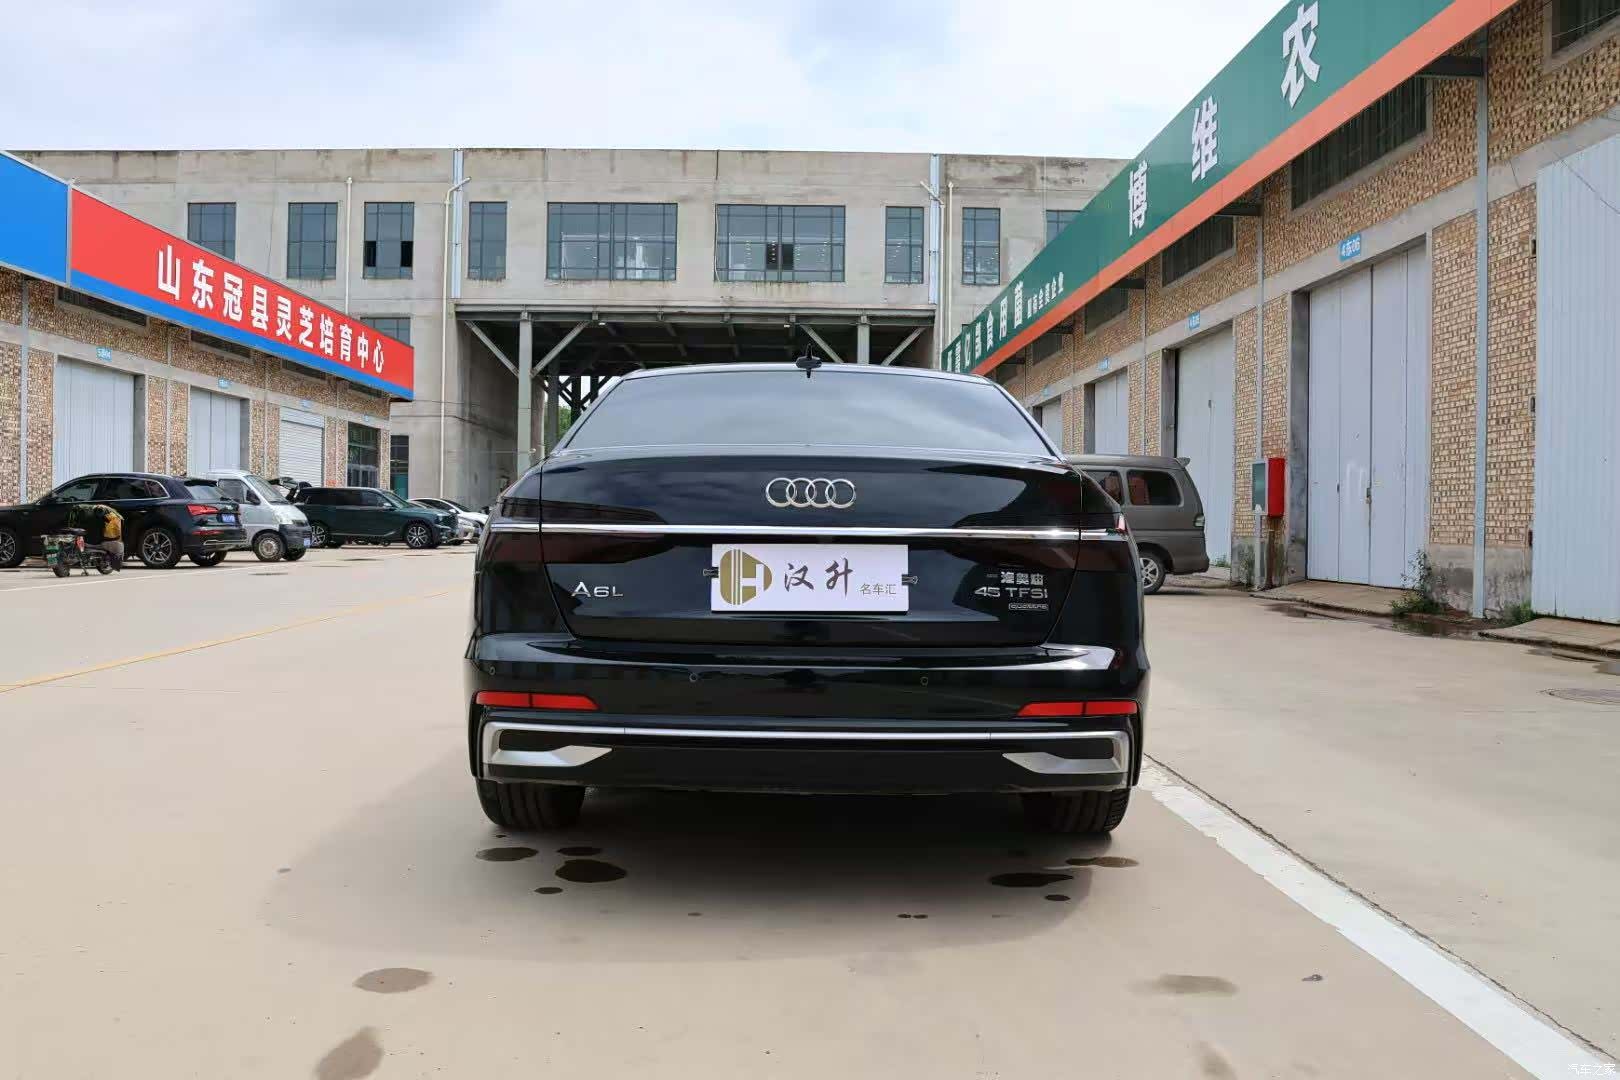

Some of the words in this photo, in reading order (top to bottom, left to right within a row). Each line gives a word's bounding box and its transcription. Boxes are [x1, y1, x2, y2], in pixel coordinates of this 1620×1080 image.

[1127, 1, 1321, 237] 博维农
[156, 244, 385, 374] 山东冠县灵芝培育中心
[572, 581, 624, 598] A6L
[784, 557, 853, 597] 汉升
[860, 583, 897, 596] 名车汇
[974, 586, 1001, 598] 45
